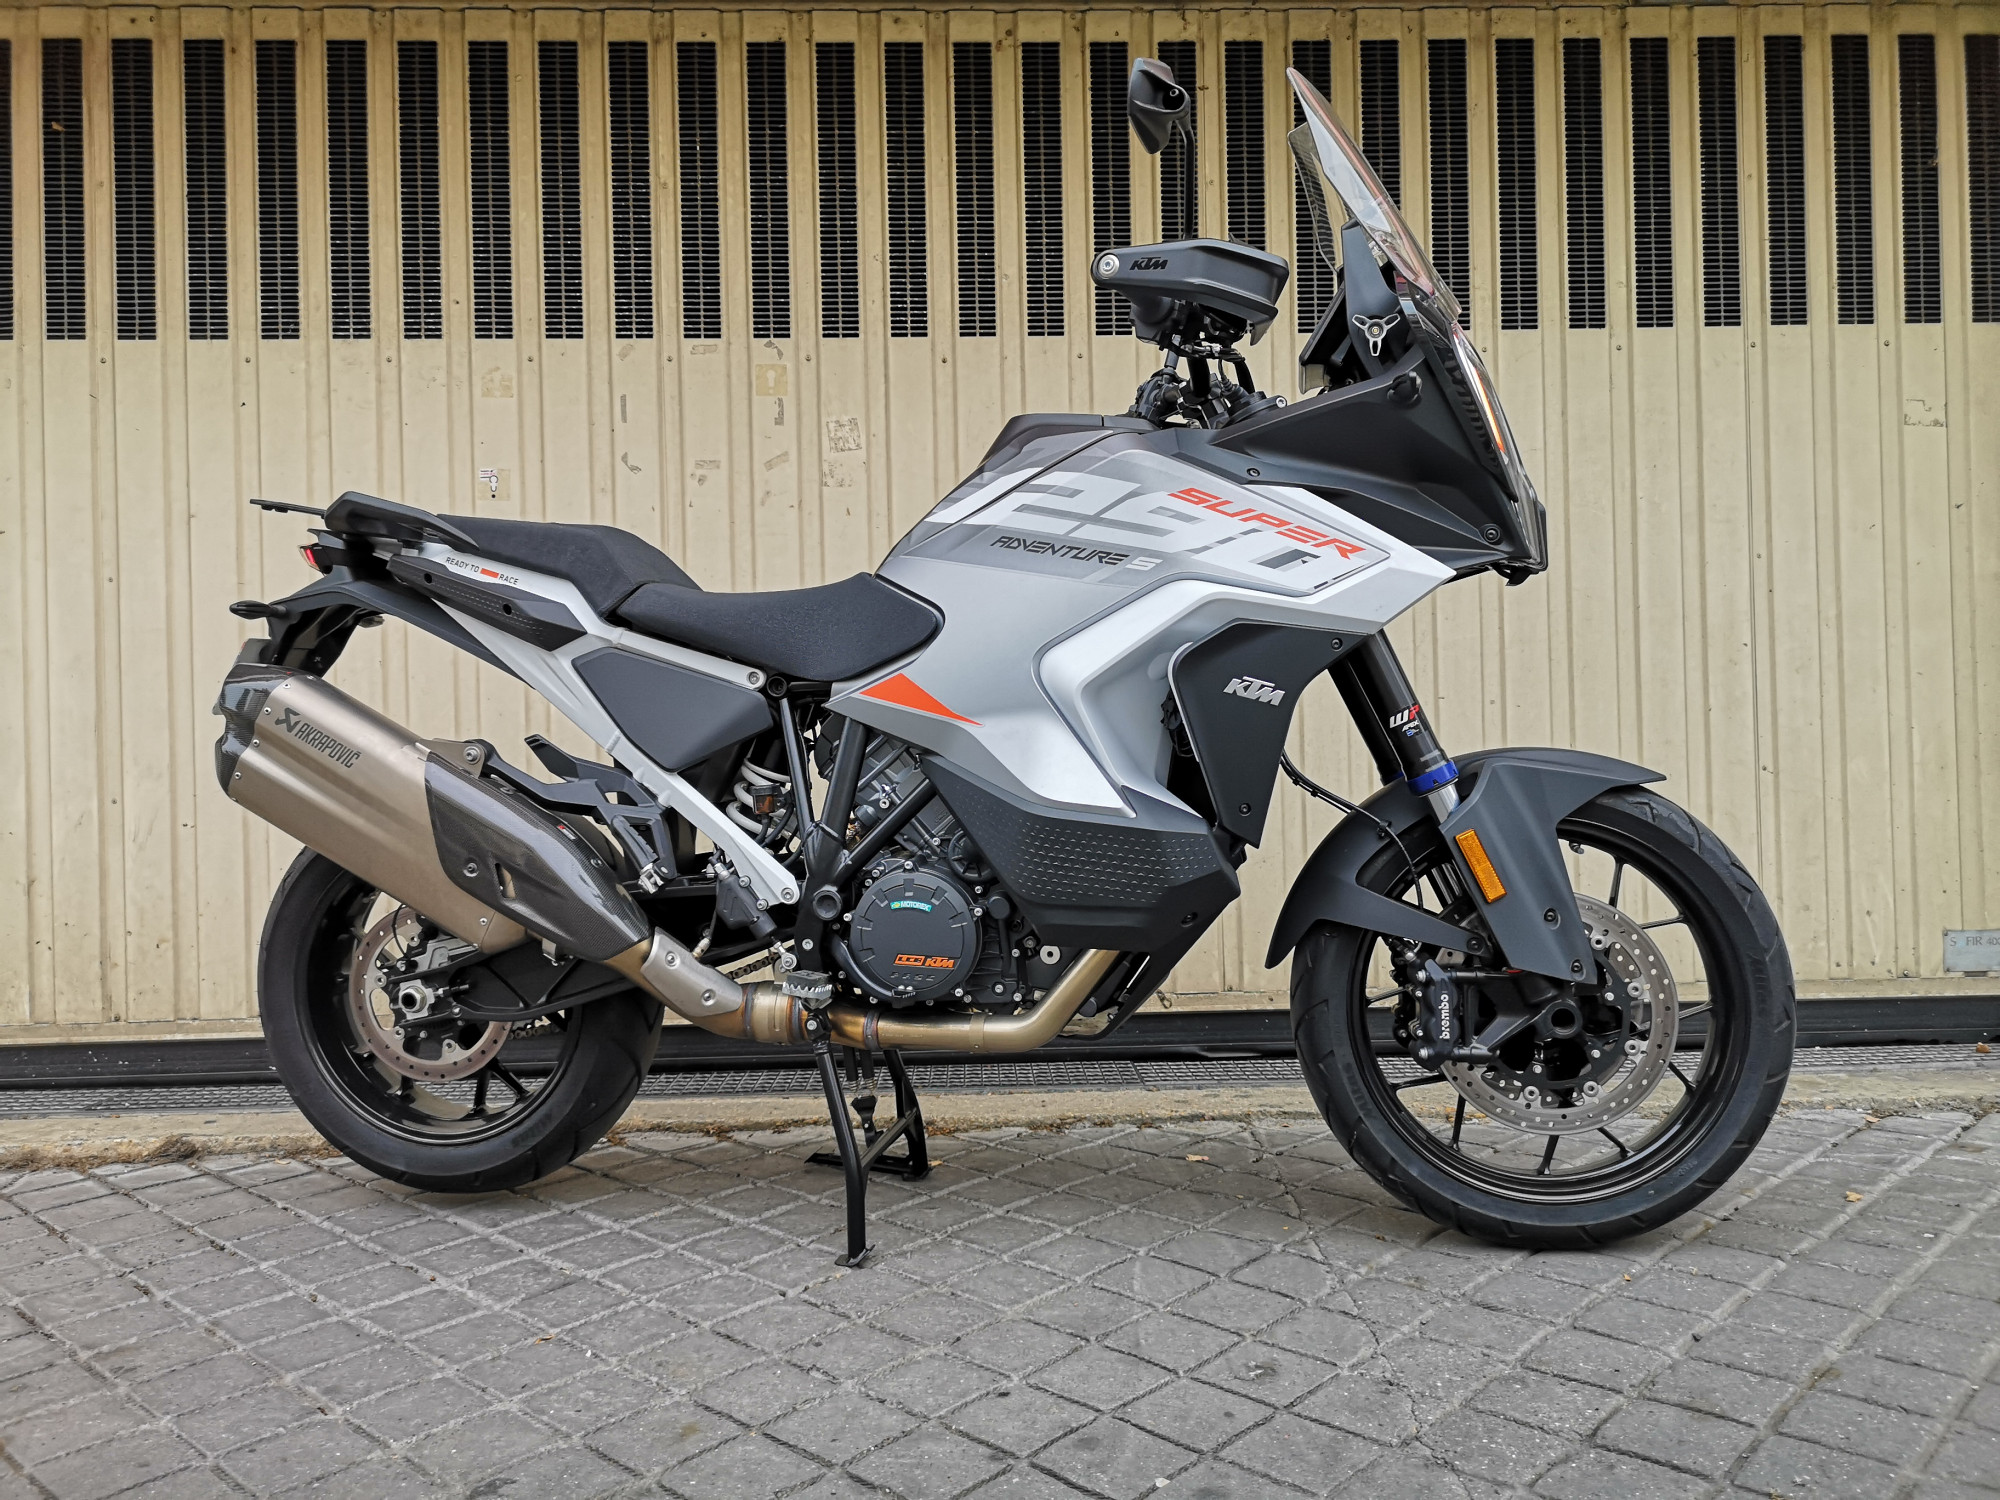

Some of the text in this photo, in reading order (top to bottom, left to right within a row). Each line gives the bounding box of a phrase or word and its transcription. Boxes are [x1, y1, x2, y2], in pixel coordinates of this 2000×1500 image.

[1129, 256, 1169, 270] KTM
[1167, 487, 1367, 560] SUPER
[990, 535, 1160, 571] ADVENTURE S
[445, 556, 519, 585] READY TO RACE
[1223, 676, 1286, 706] KTM
[1949, 936, 1957, 947] S
[1966, 936, 1983, 946] FIR
[925, 957, 955, 968] KTM
[1438, 993, 1451, 1040] brembo
